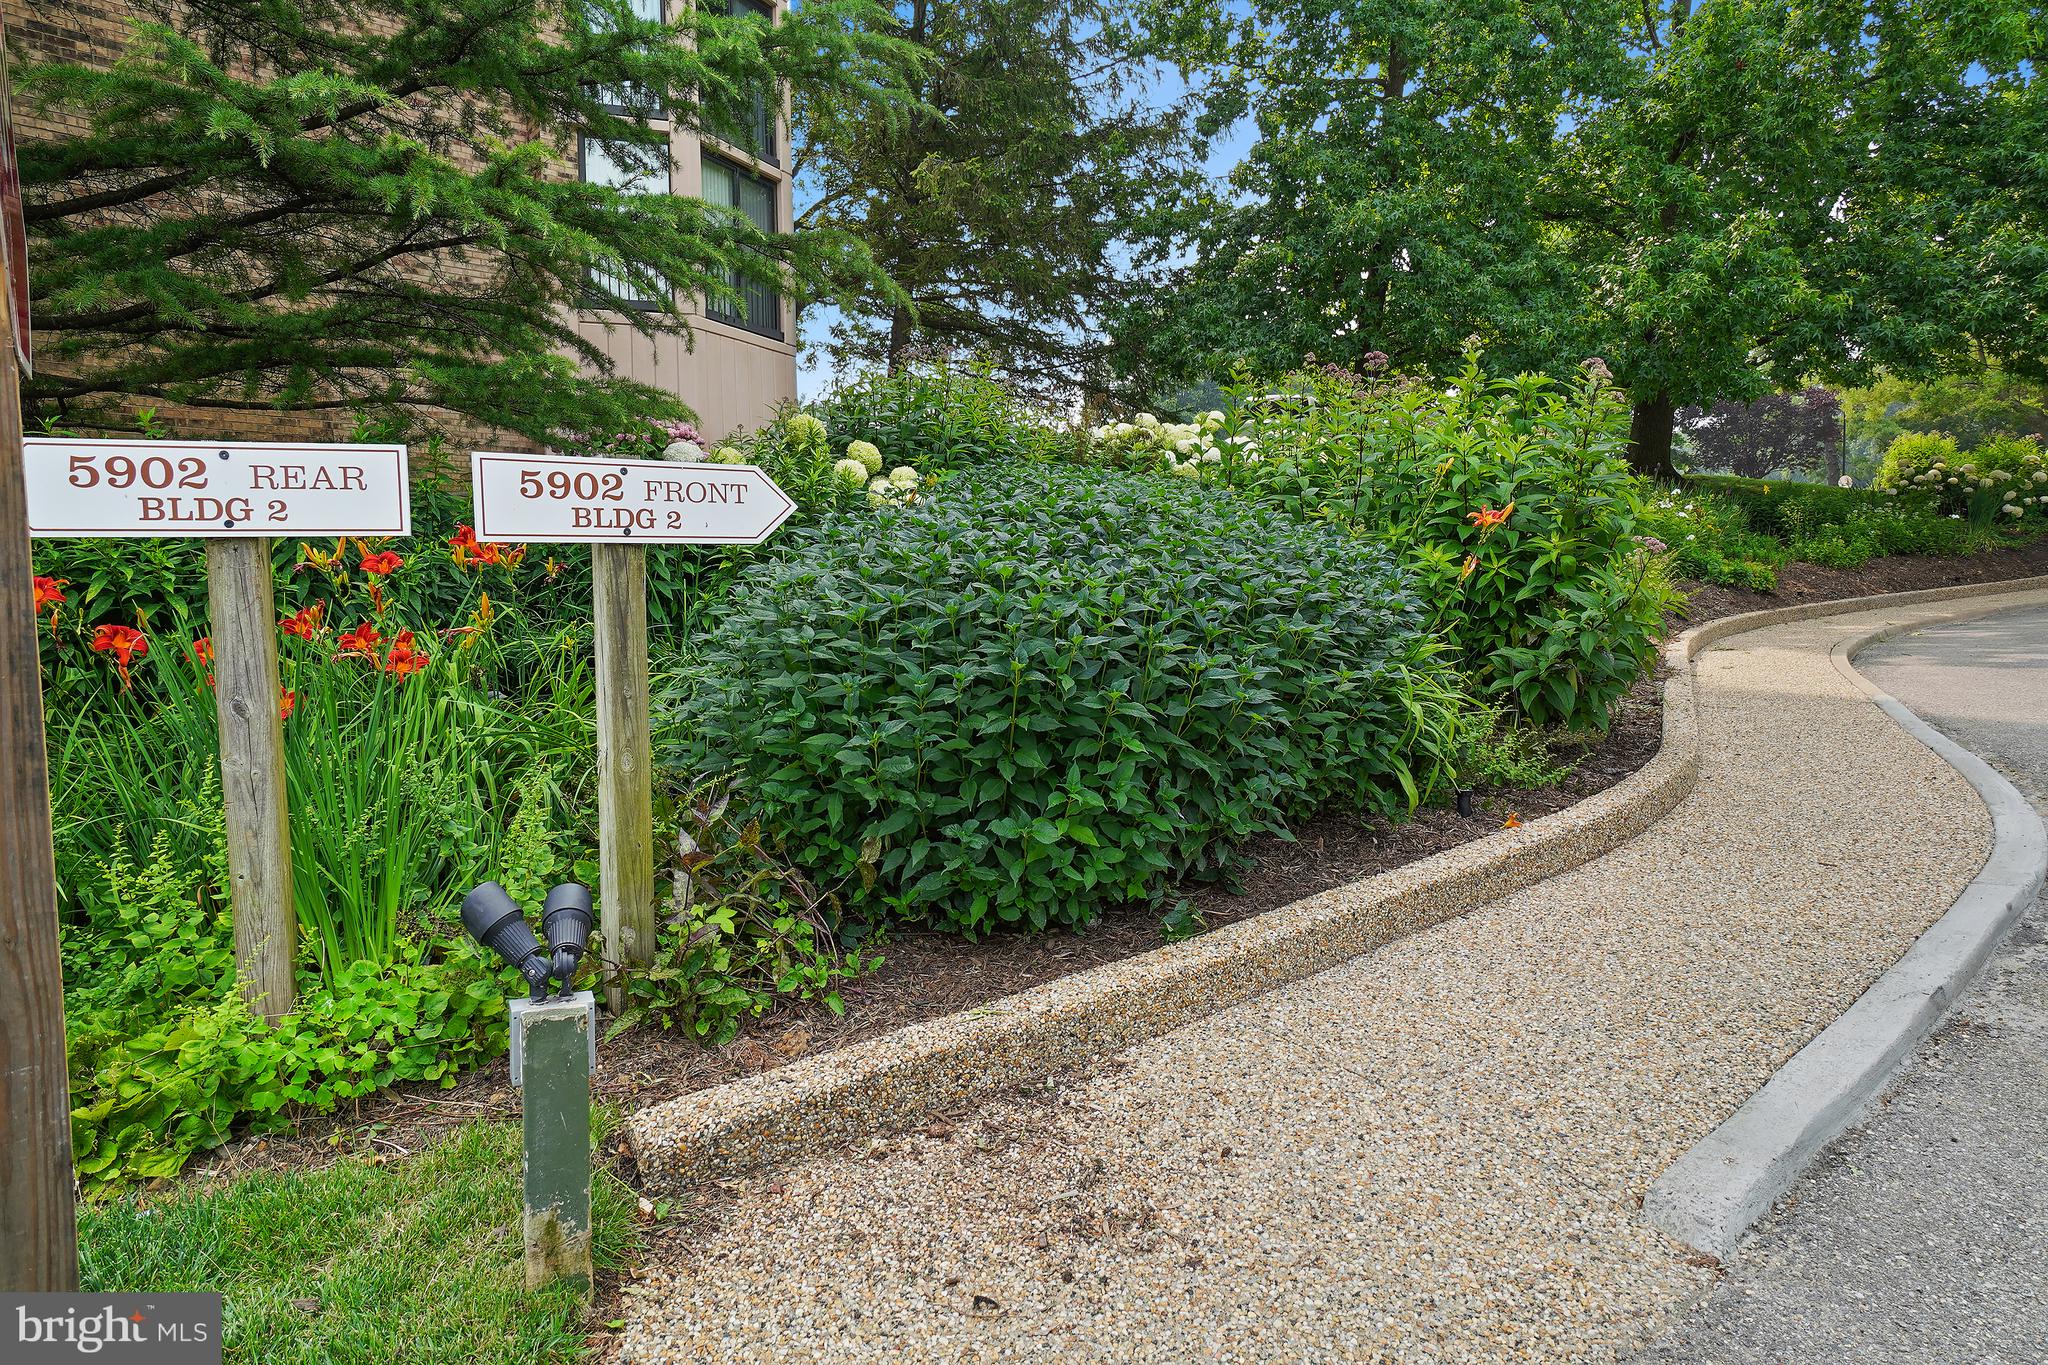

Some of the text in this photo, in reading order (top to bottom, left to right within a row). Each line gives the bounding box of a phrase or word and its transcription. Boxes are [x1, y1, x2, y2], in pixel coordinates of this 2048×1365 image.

[68, 455, 368, 491] 5902 REAR
[519, 469, 748, 504] 5902 FRONT
[137, 497, 289, 522] BLDG 2
[571, 507, 682, 530] BLDG 2
